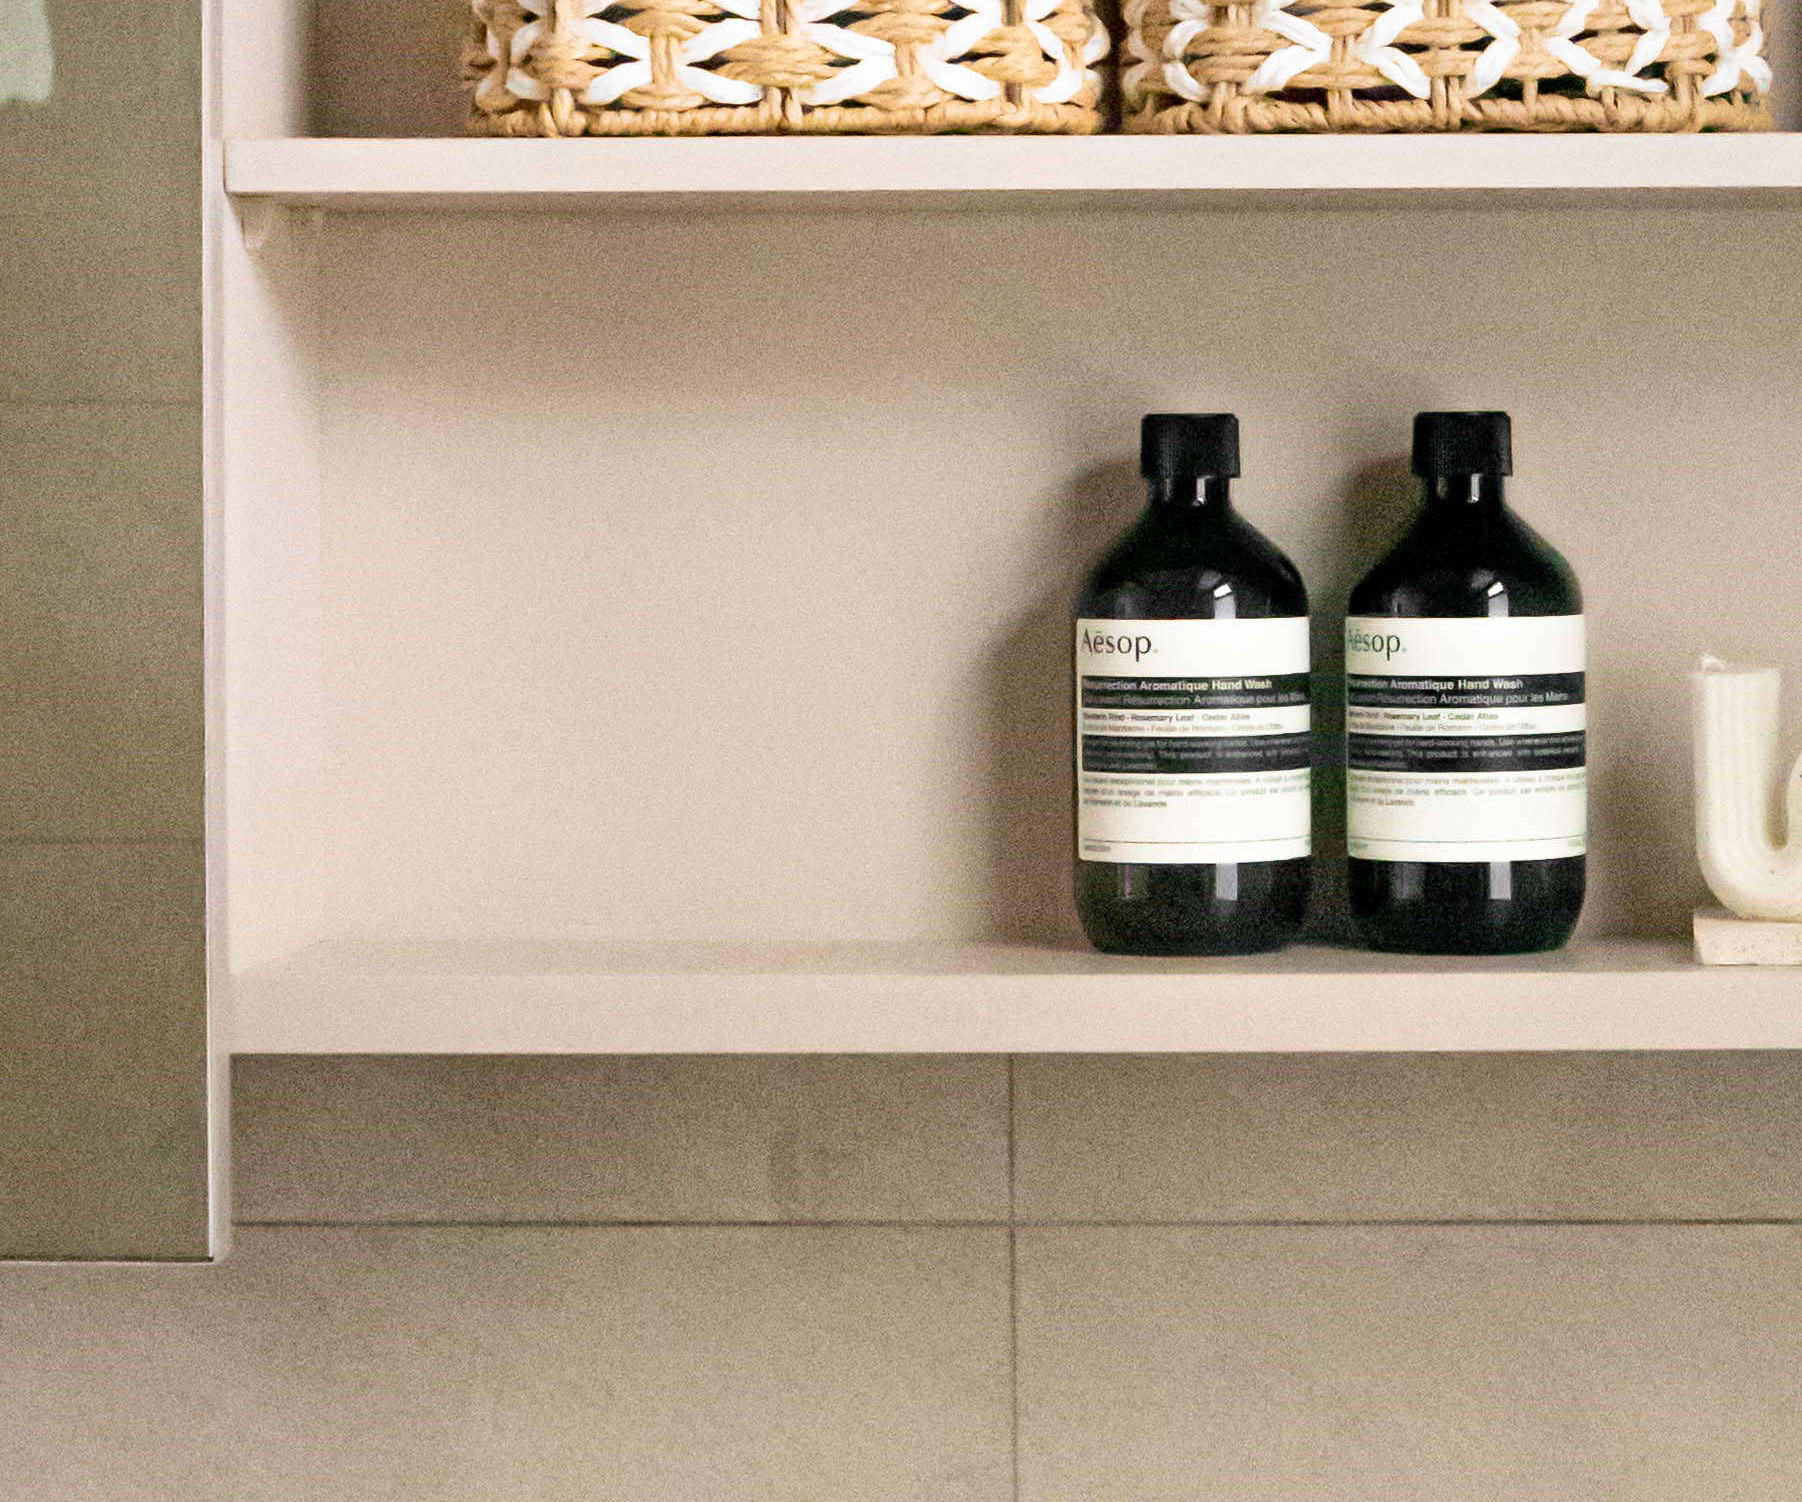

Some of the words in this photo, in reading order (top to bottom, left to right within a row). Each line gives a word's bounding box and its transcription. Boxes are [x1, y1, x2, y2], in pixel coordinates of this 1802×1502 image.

[1139, 680, 1209, 693] Aromatique
[1211, 679, 1242, 690] Hand
[1244, 679, 1272, 690] Wash
[1390, 679, 1454, 692] Aromatique
[1457, 678, 1490, 689] Hand
[1492, 678, 1524, 689] Wash
[1439, 693, 1504, 705] Aromatique
[1505, 694, 1528, 705] pour
